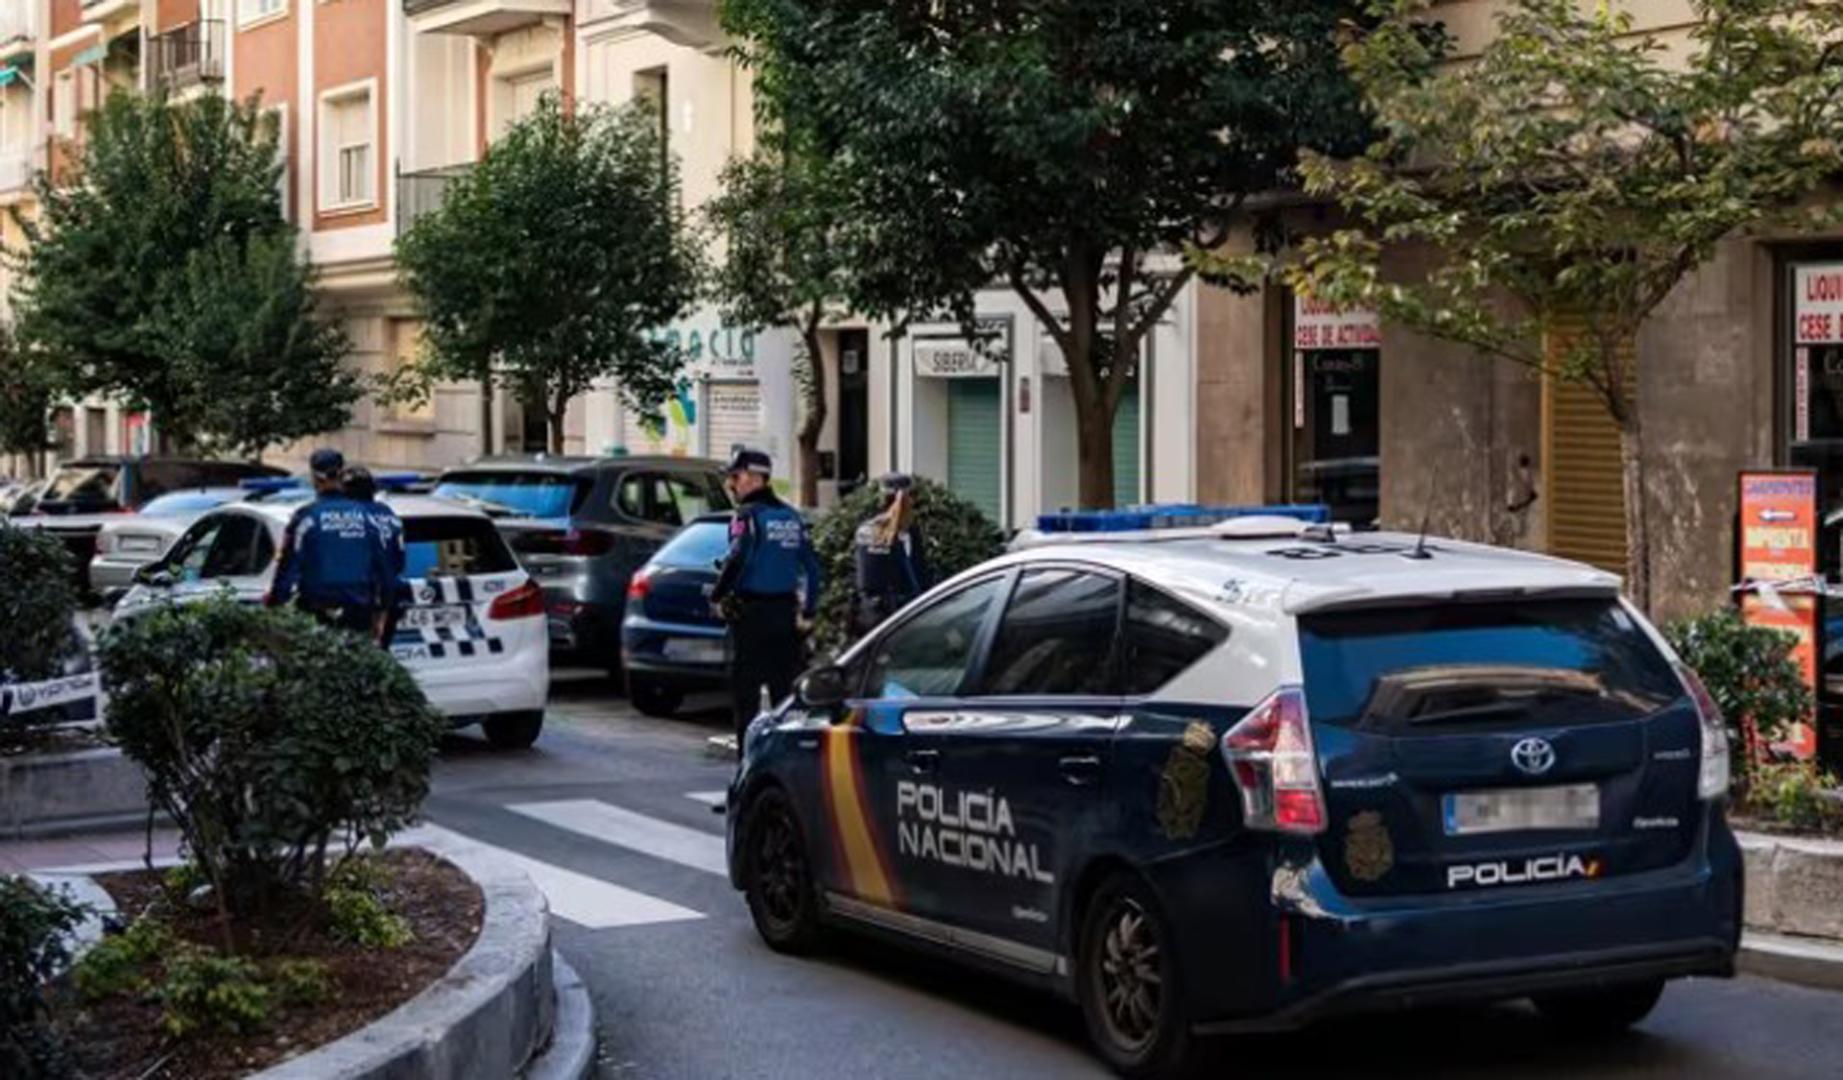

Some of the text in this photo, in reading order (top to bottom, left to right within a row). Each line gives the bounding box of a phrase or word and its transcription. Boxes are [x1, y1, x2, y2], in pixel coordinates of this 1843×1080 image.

[1297, 325, 1318, 346] CESE
[1322, 325, 1334, 345] DE
[1800, 314, 1831, 340] CESE
[897, 780, 1016, 838] POLICÍA
[898, 821, 1055, 884] NACIONAL
[1447, 852, 1586, 888] POLICÍA
